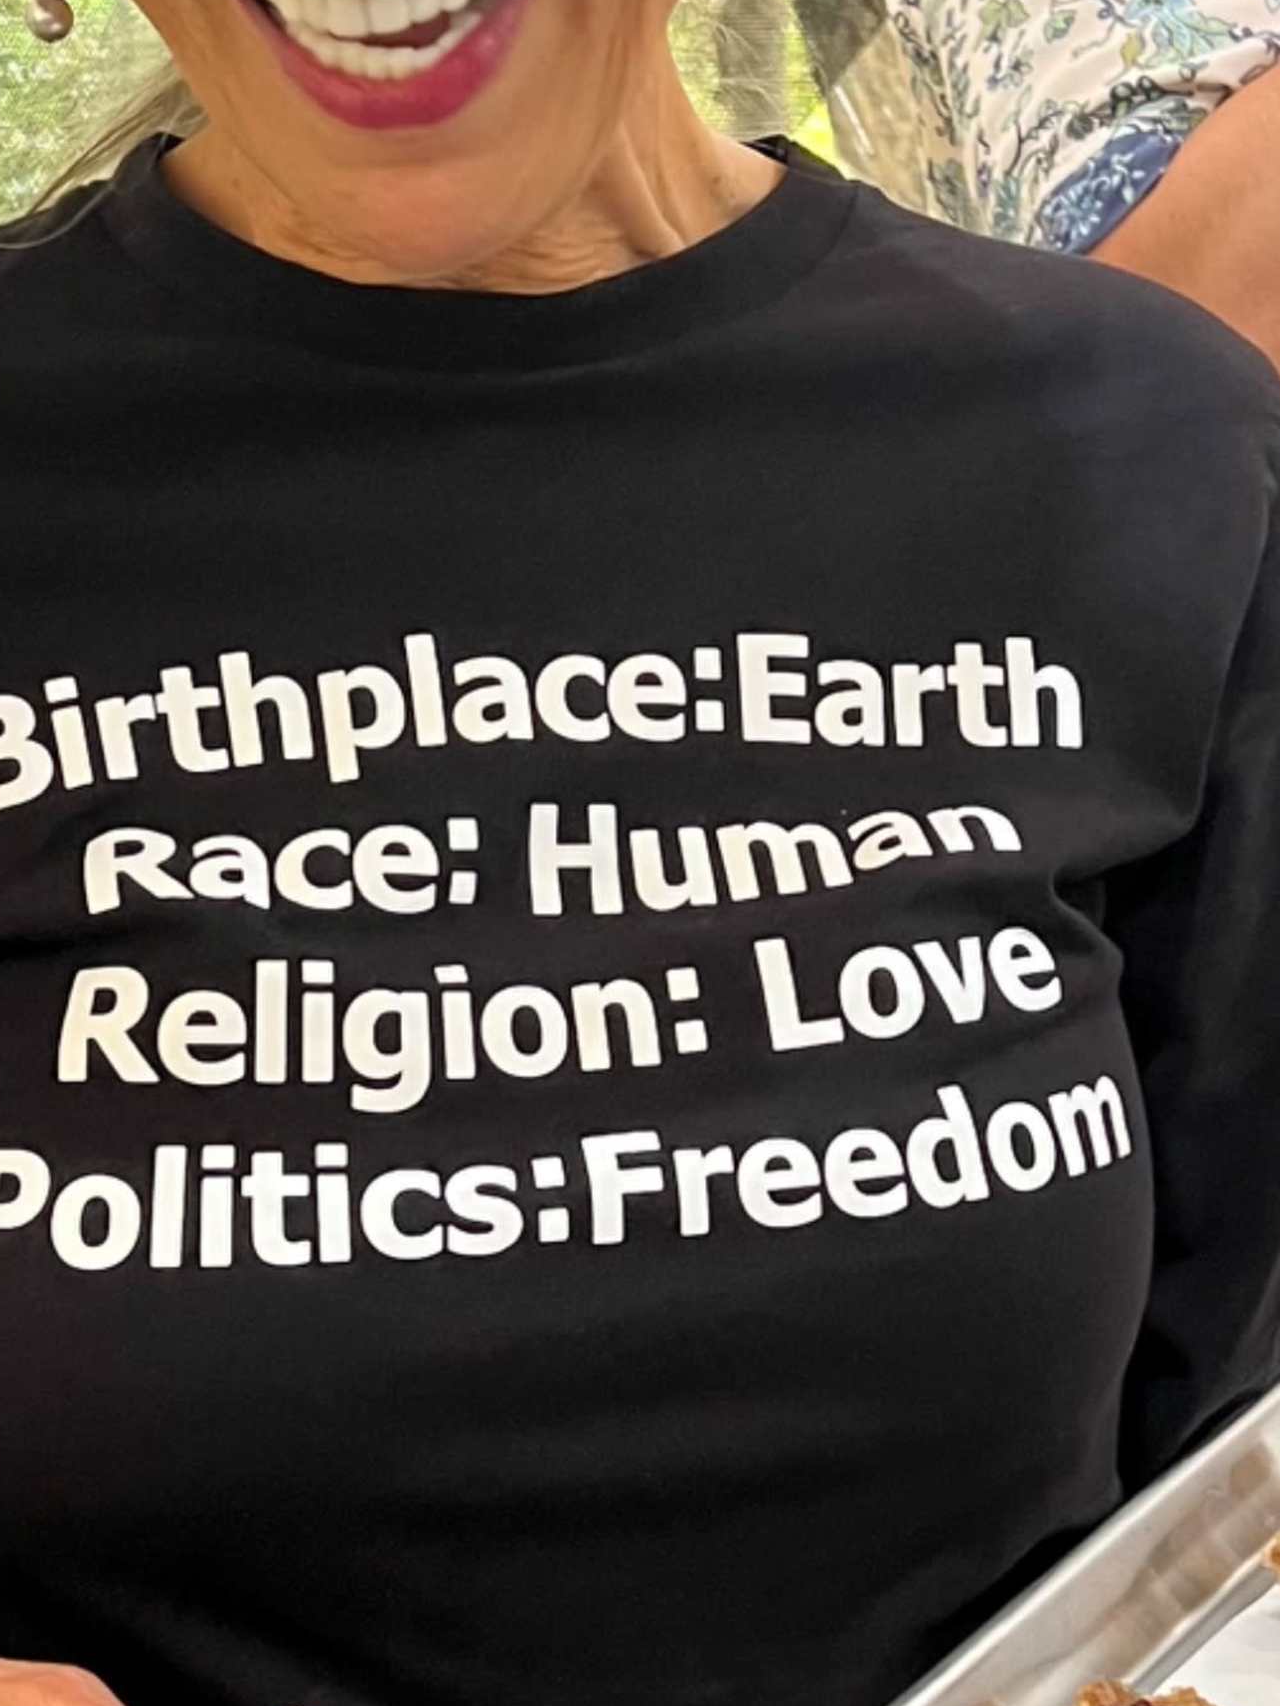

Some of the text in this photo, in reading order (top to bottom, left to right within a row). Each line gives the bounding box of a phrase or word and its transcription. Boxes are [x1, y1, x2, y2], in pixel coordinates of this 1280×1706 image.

[84, 803, 1022, 915] Race: Human
[58, 927, 1062, 1113] Religion: Love
